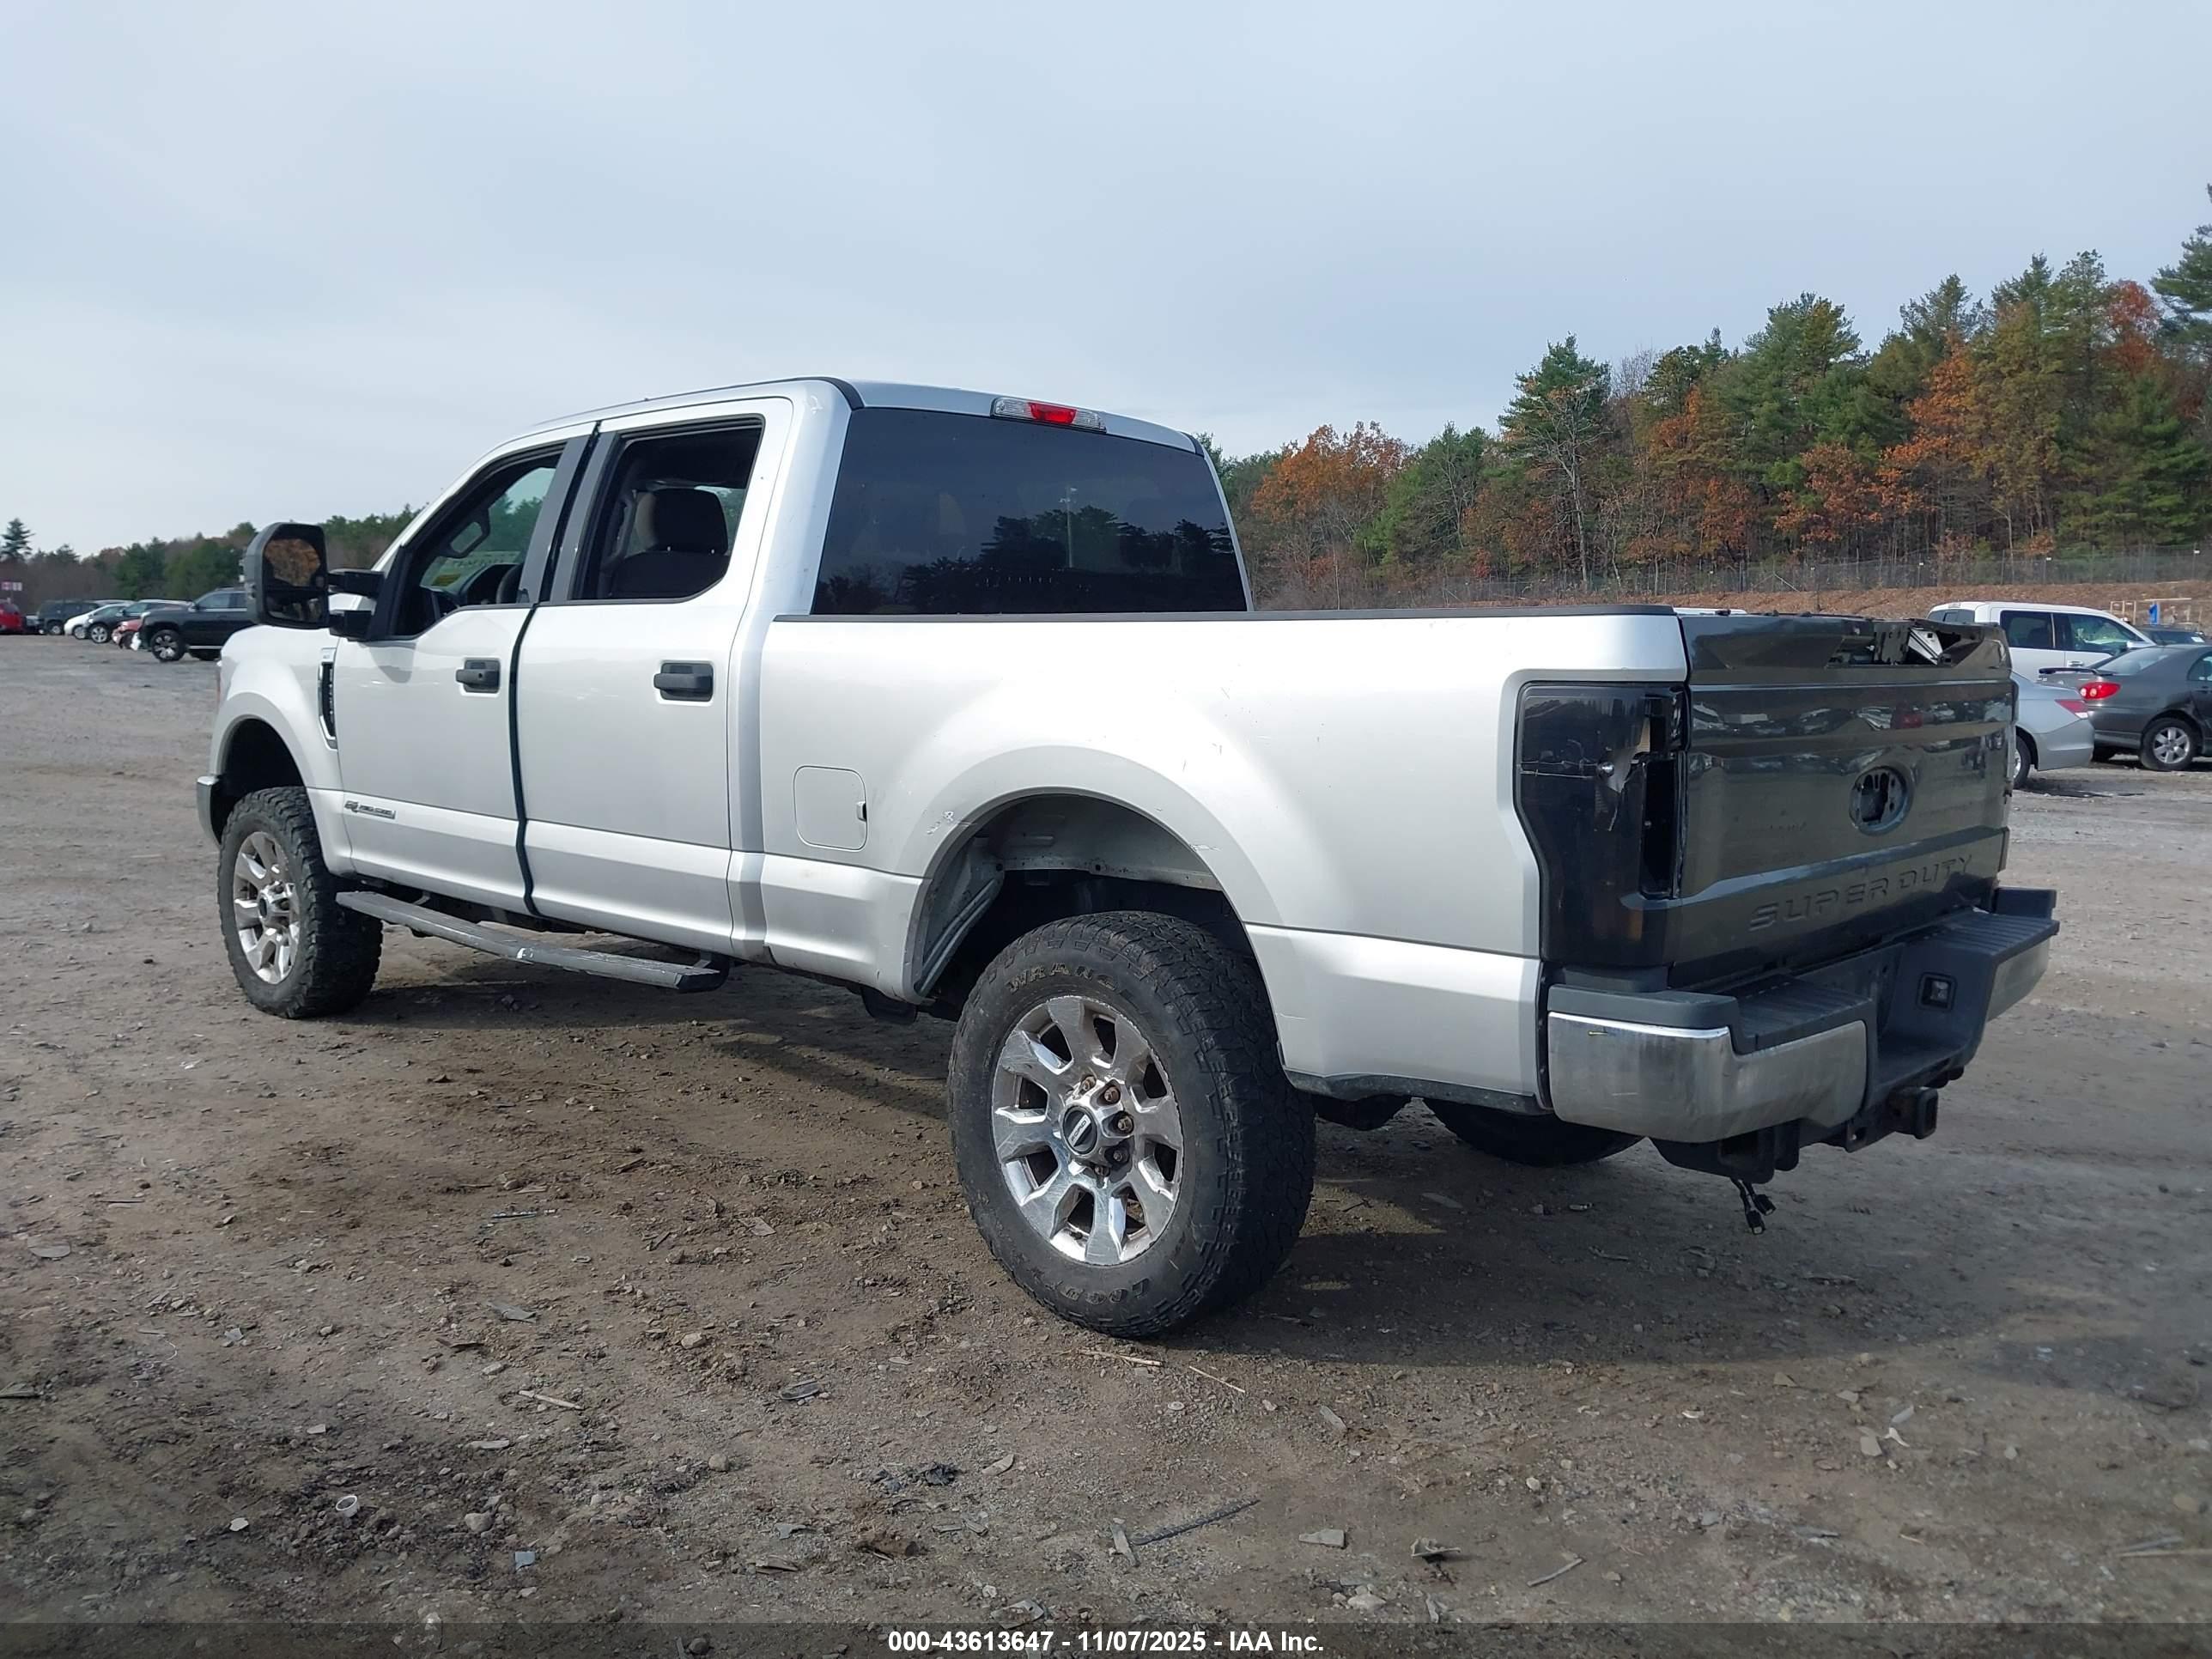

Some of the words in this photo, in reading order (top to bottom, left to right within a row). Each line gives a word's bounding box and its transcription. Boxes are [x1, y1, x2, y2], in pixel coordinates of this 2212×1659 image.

[1748, 877, 1890, 932] SUPER
[1899, 854, 1972, 889] DUTY
[1071, 1119, 1088, 1143] FORD
